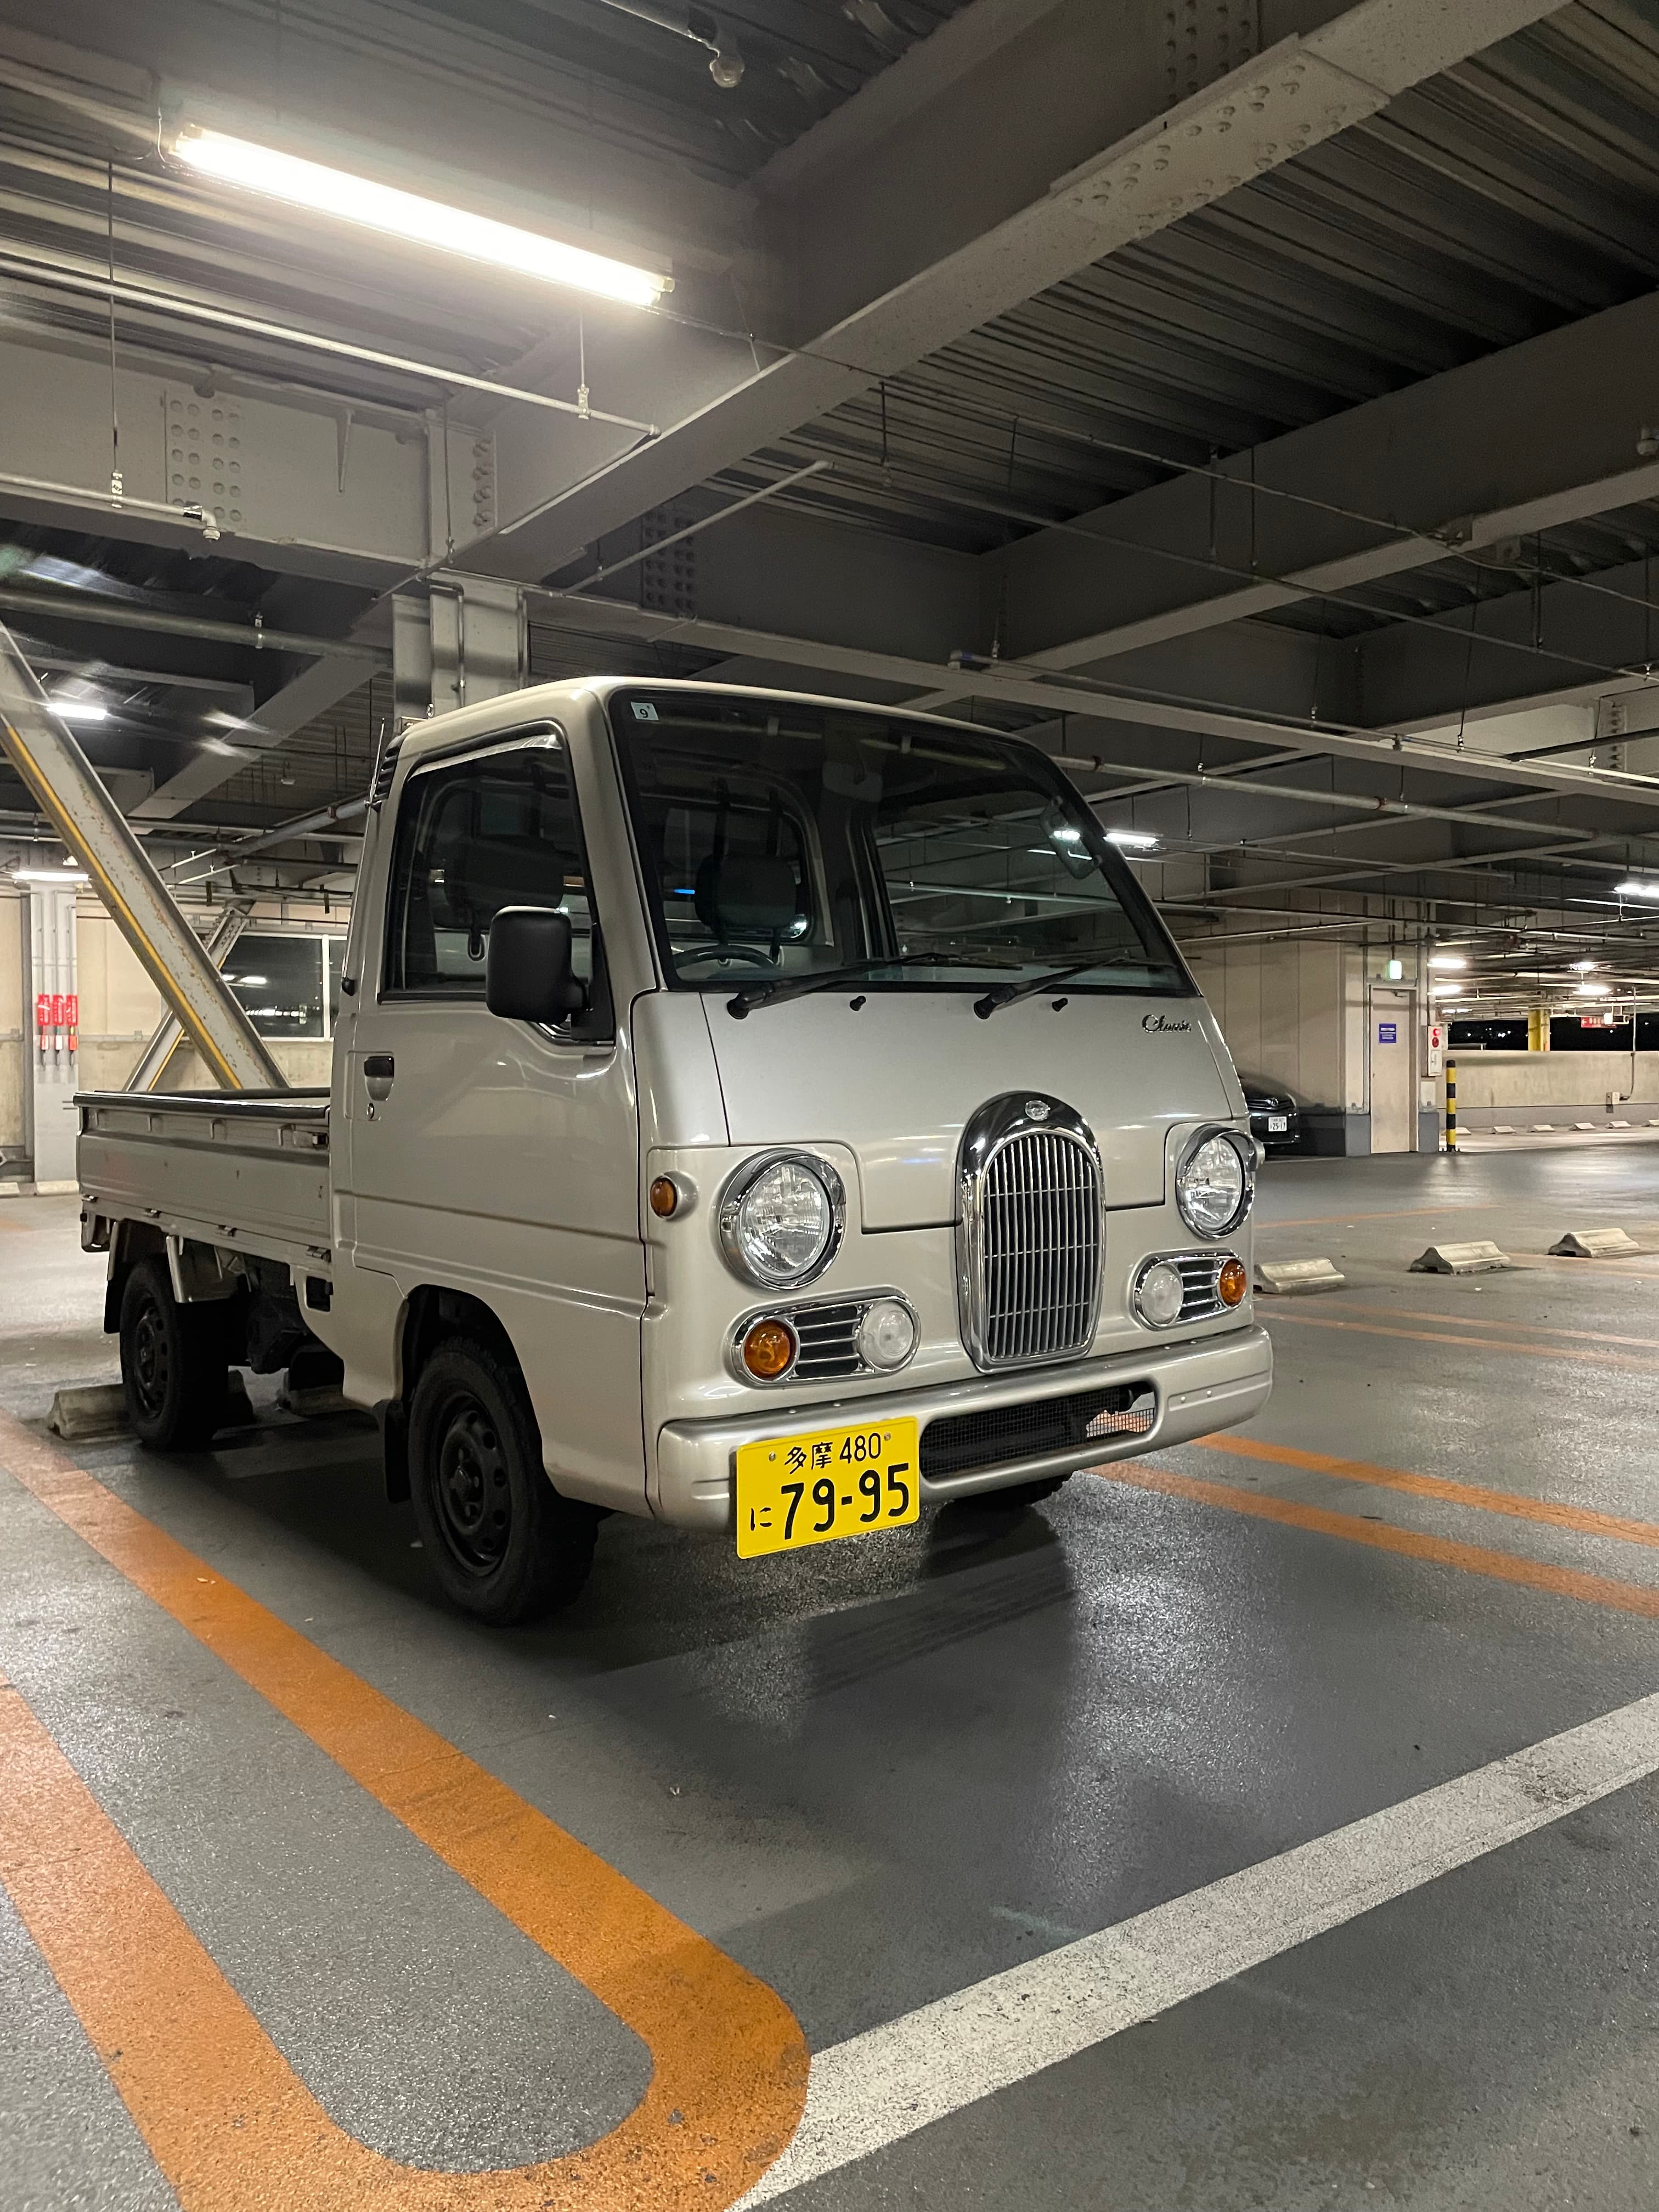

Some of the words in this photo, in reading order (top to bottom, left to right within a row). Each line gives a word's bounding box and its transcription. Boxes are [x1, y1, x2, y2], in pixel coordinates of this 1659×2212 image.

[640, 708, 648, 718] 9
[784, 1442, 833, 1474] 多摩
[839, 1432, 881, 1464] 480
[750, 1506, 772, 1531] に
[781, 1462, 909, 1541] 79-95
